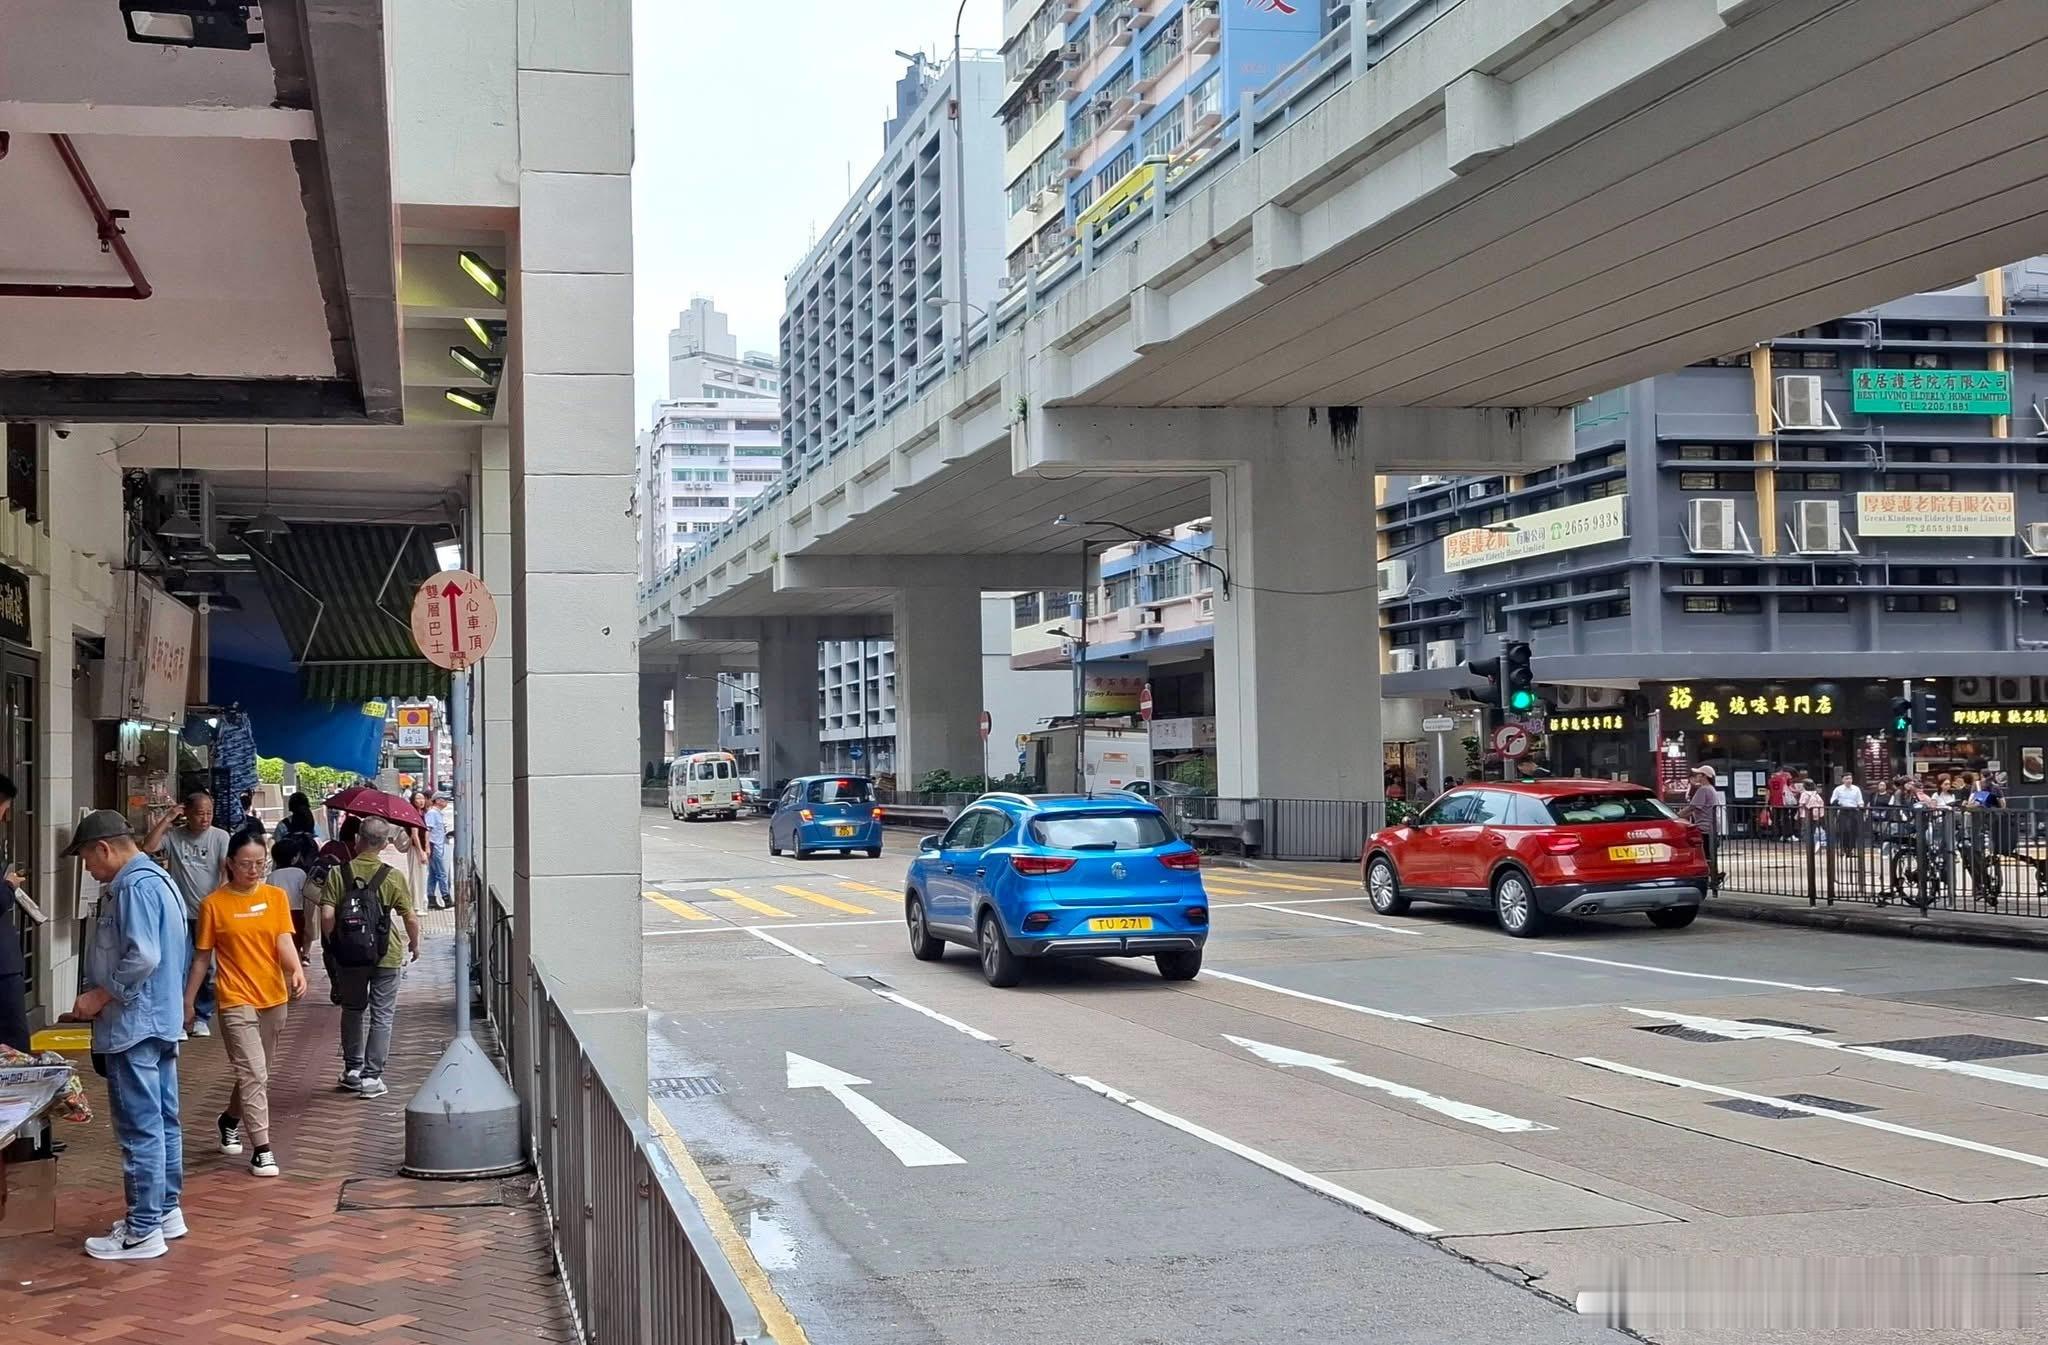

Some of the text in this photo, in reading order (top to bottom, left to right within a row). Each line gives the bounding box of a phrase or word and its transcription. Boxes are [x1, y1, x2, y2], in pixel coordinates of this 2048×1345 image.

[1858, 391, 1877, 400] BEST
[1880, 391, 1907, 400] LIVING
[1949, 391, 1973, 401] HOME
[1975, 391, 2008, 402] LIMITED
[1564, 511, 1619, 536] 2655 9338
[1979, 514, 2012, 522] Limited
[465, 579, 482, 651] 小心車頂
[1616, 847, 1630, 858] LY
[1096, 918, 1143, 929] TU 271
